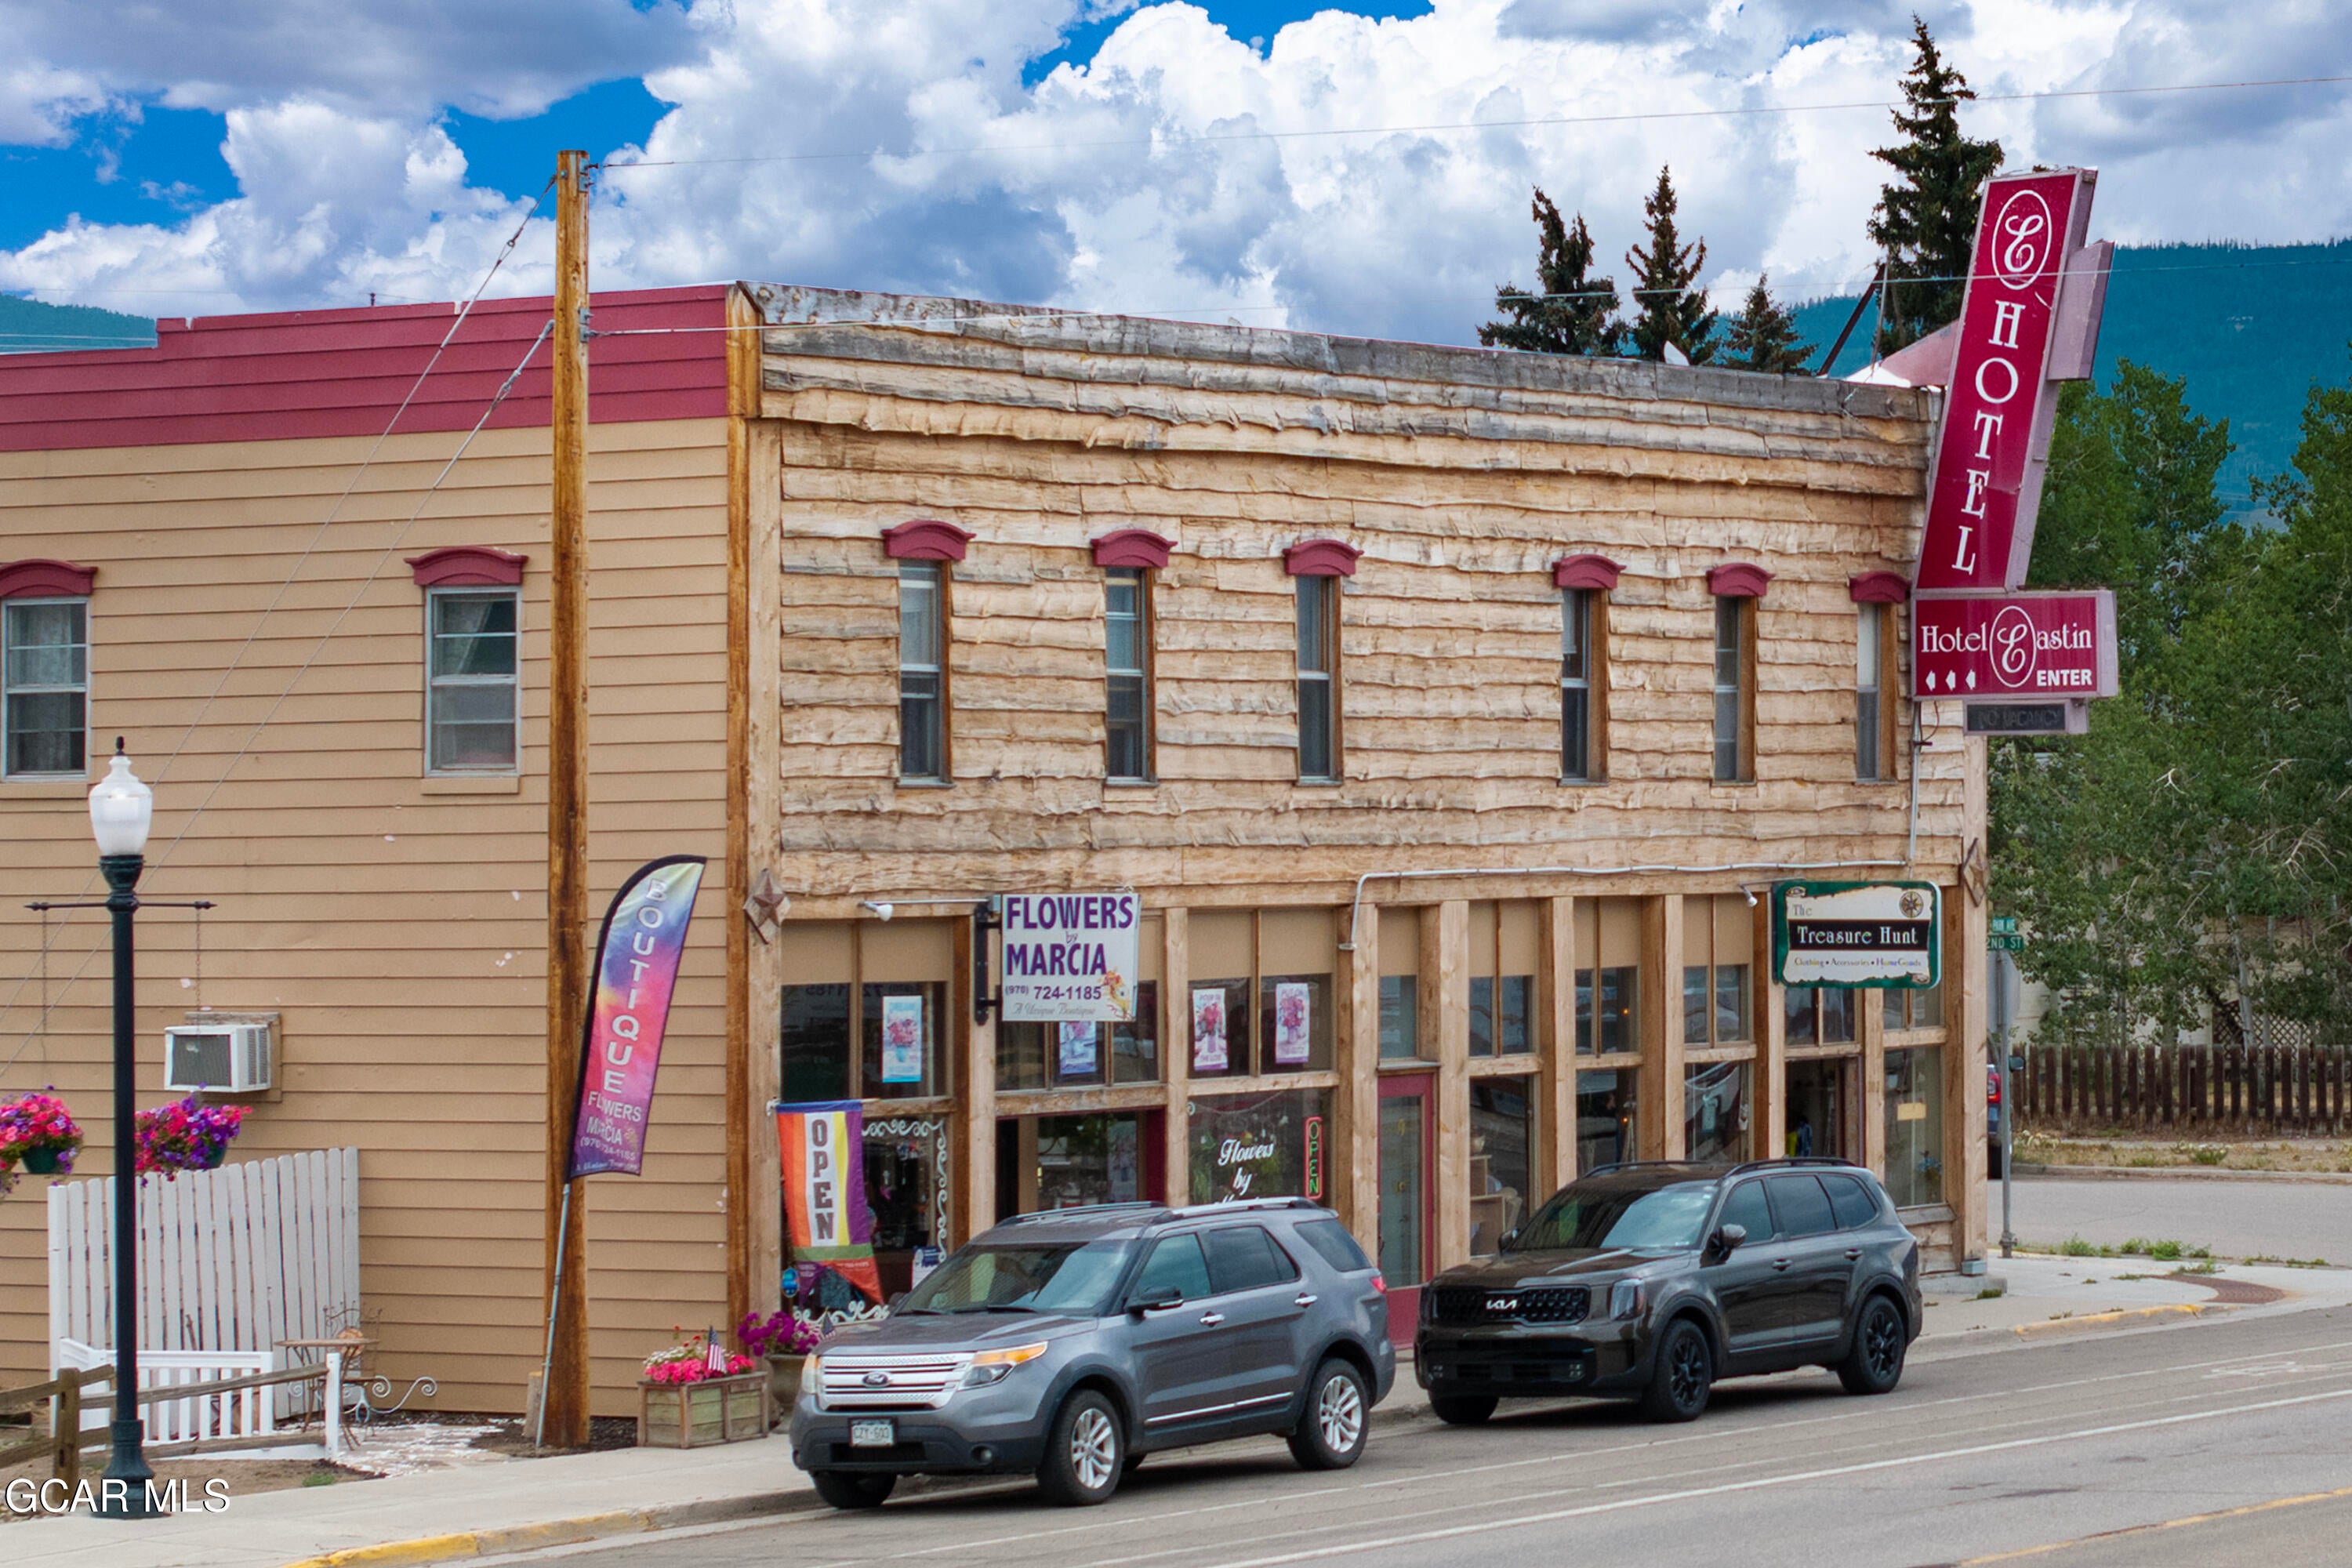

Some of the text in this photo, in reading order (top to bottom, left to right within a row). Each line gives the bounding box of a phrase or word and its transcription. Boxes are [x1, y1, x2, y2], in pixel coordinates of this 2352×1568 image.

[1951, 299, 2026, 575] HOTEL
[1921, 622, 1987, 653] Hotel
[2037, 669, 2092, 687] ENTER
[2002, 709, 2063, 727] VACANCY
[1006, 896, 1134, 930] FLOWERS
[1792, 904, 1813, 916] The
[1065, 931, 1078, 944] by
[1797, 925, 1918, 945] Treasure Hunt
[1987, 937, 2021, 949] 2ND ST
[1006, 943, 1107, 976] MARCIA
[604, 877, 666, 1094] BOUTIQUE
[1005, 985, 1102, 1000] (970) 724-1185
[588, 1091, 642, 1123] FLWERS
[1218, 1138, 1275, 1167] Flowers
[1308, 1121, 1319, 1194] OPEN
[812, 1119, 834, 1240] OPEN
[1232, 1167, 1253, 1196] by
